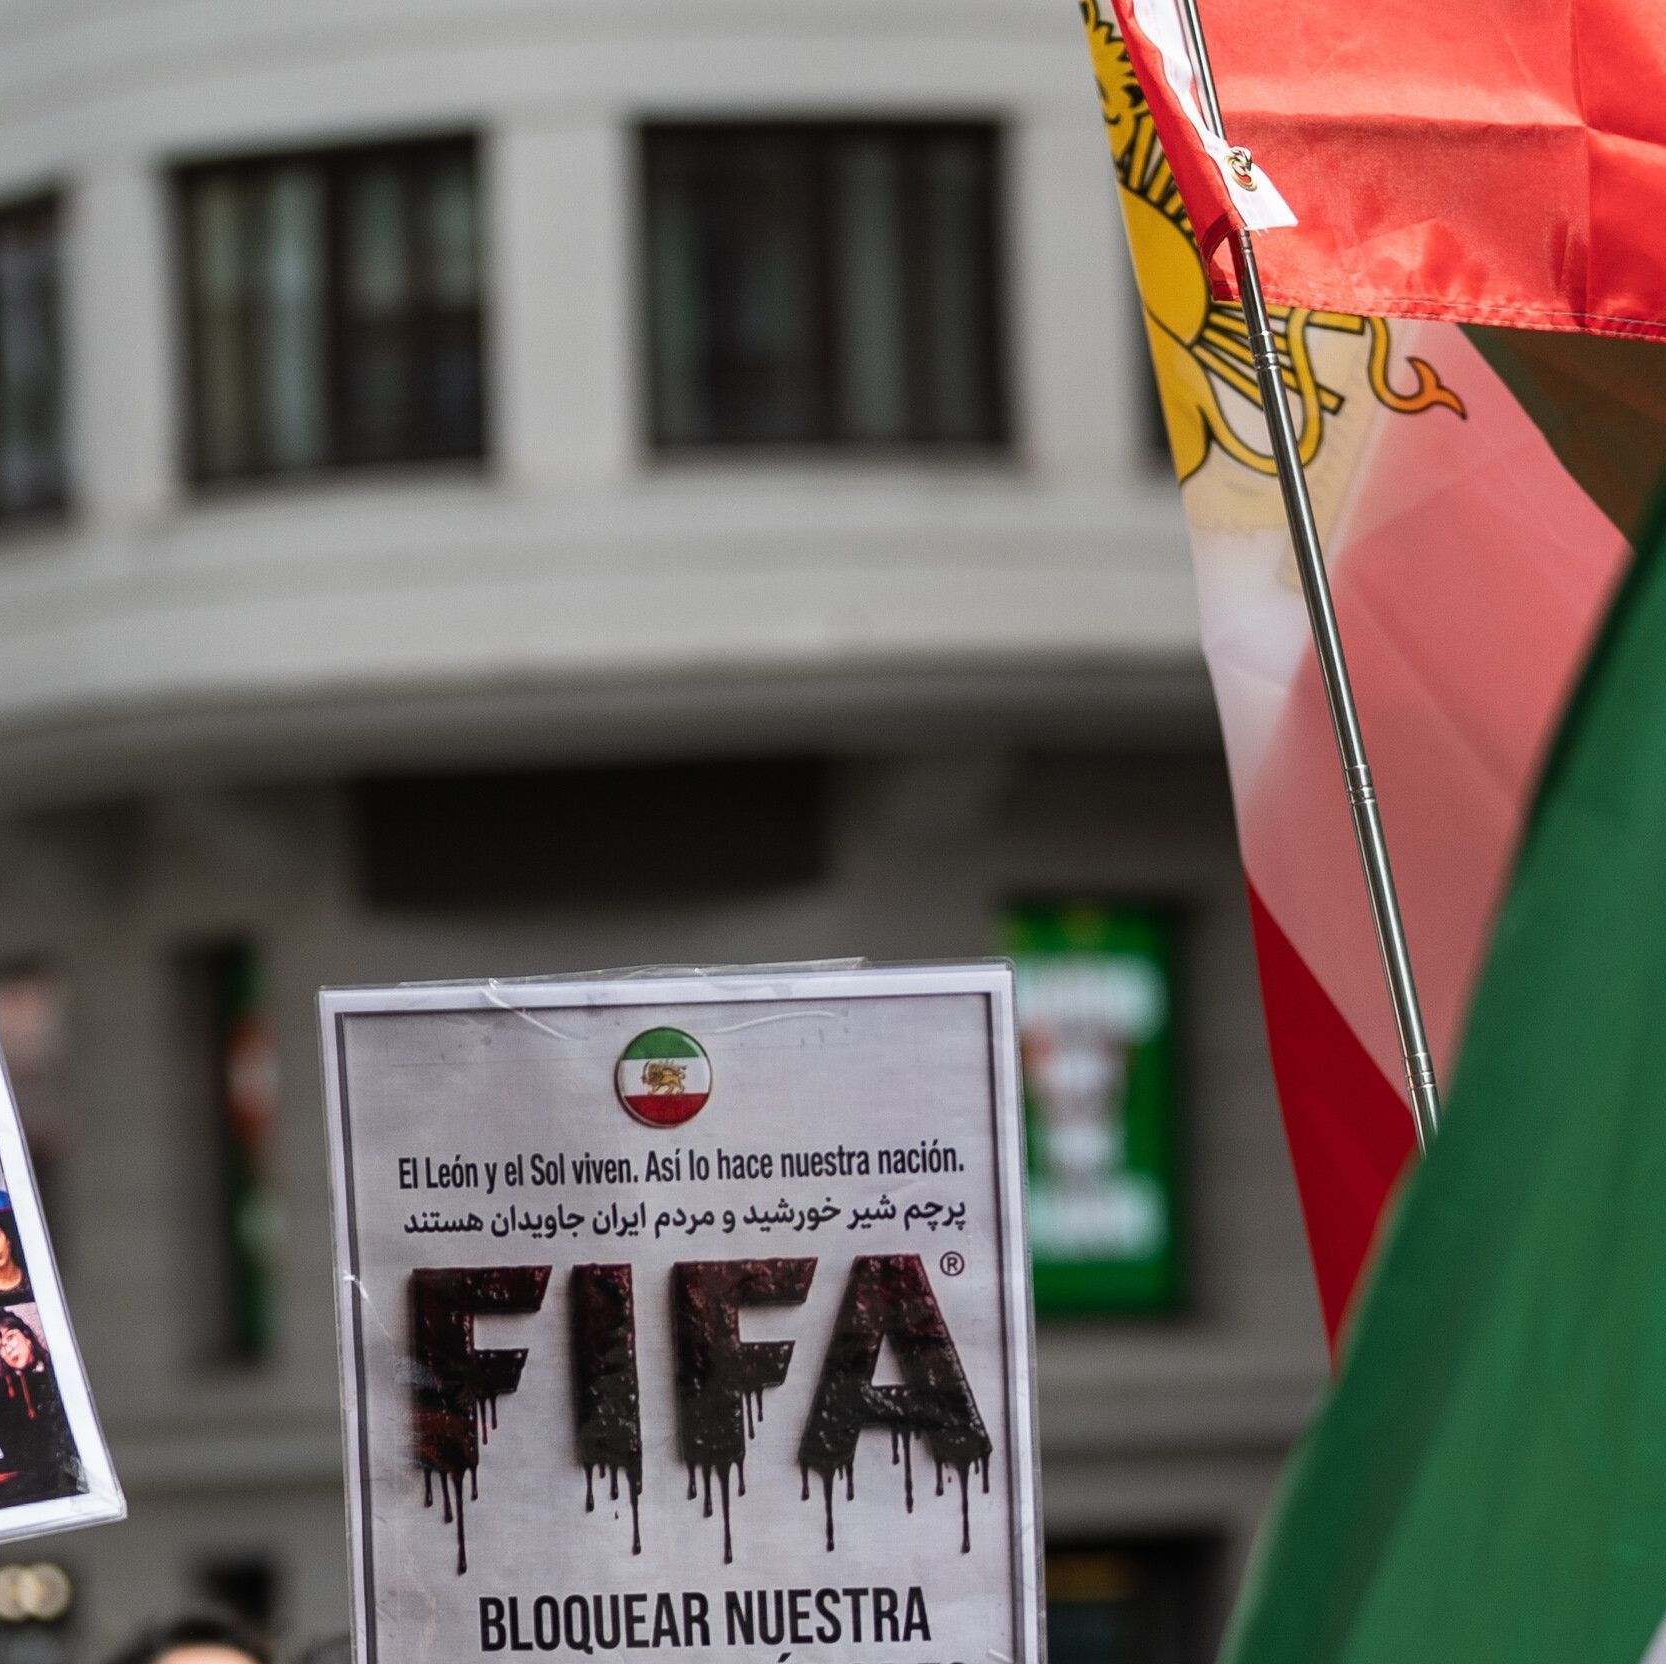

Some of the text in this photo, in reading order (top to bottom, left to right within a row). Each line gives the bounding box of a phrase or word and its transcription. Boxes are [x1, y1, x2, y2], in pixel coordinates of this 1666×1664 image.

[398, 1138, 965, 1195] El León y el Sol viven. Así lo hace nuestra nación.
[403, 1194, 966, 1238] پرچم شیر خورشید و مردم ایران جاویدان هستند
[409, 1254, 993, 1510] FIFA
[479, 1586, 931, 1652] BLOQUEAR NUESTRA
